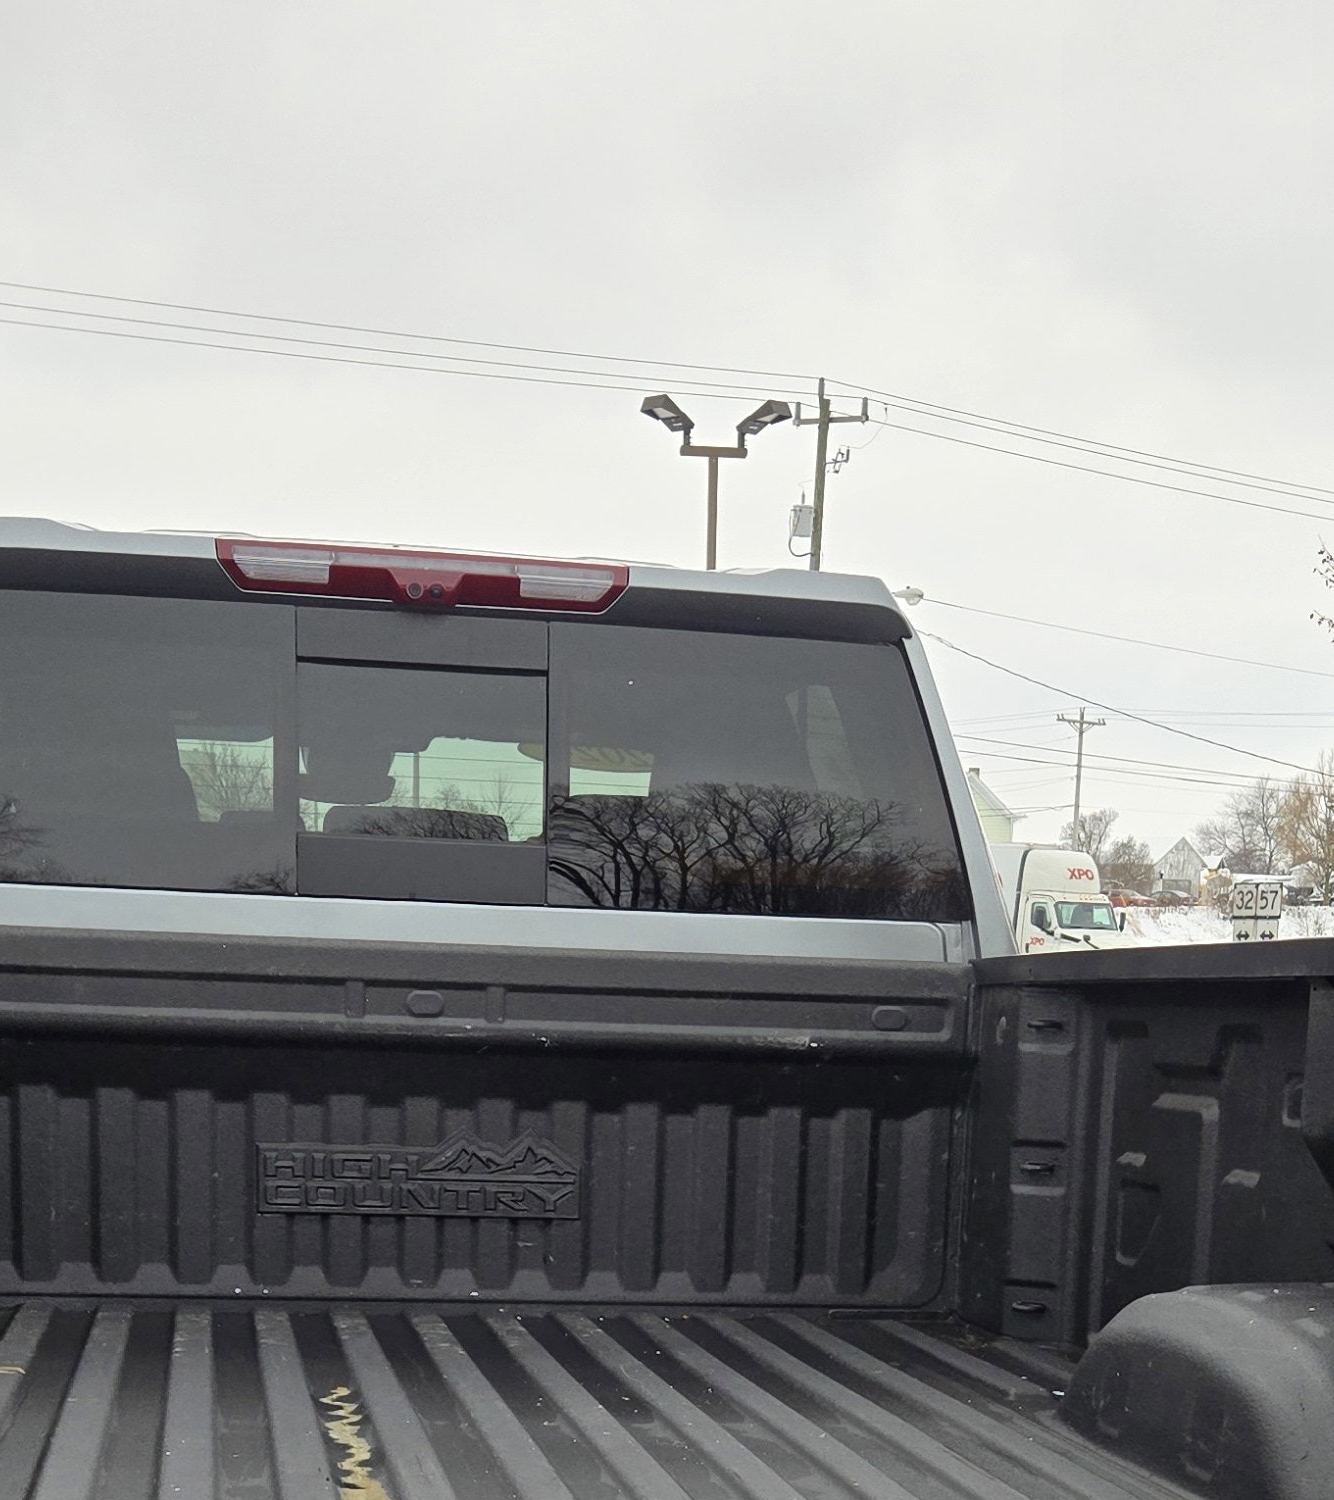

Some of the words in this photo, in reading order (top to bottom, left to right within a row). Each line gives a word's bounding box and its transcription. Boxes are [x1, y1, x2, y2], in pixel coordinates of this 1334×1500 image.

[1067, 867, 1095, 881] XPO
[1235, 890, 1254, 910] 32
[1259, 890, 1278, 910] 57
[1029, 936, 1045, 946] XPO
[264, 1151, 419, 1181] HIGH
[265, 1181, 575, 1213] COUNTRY
